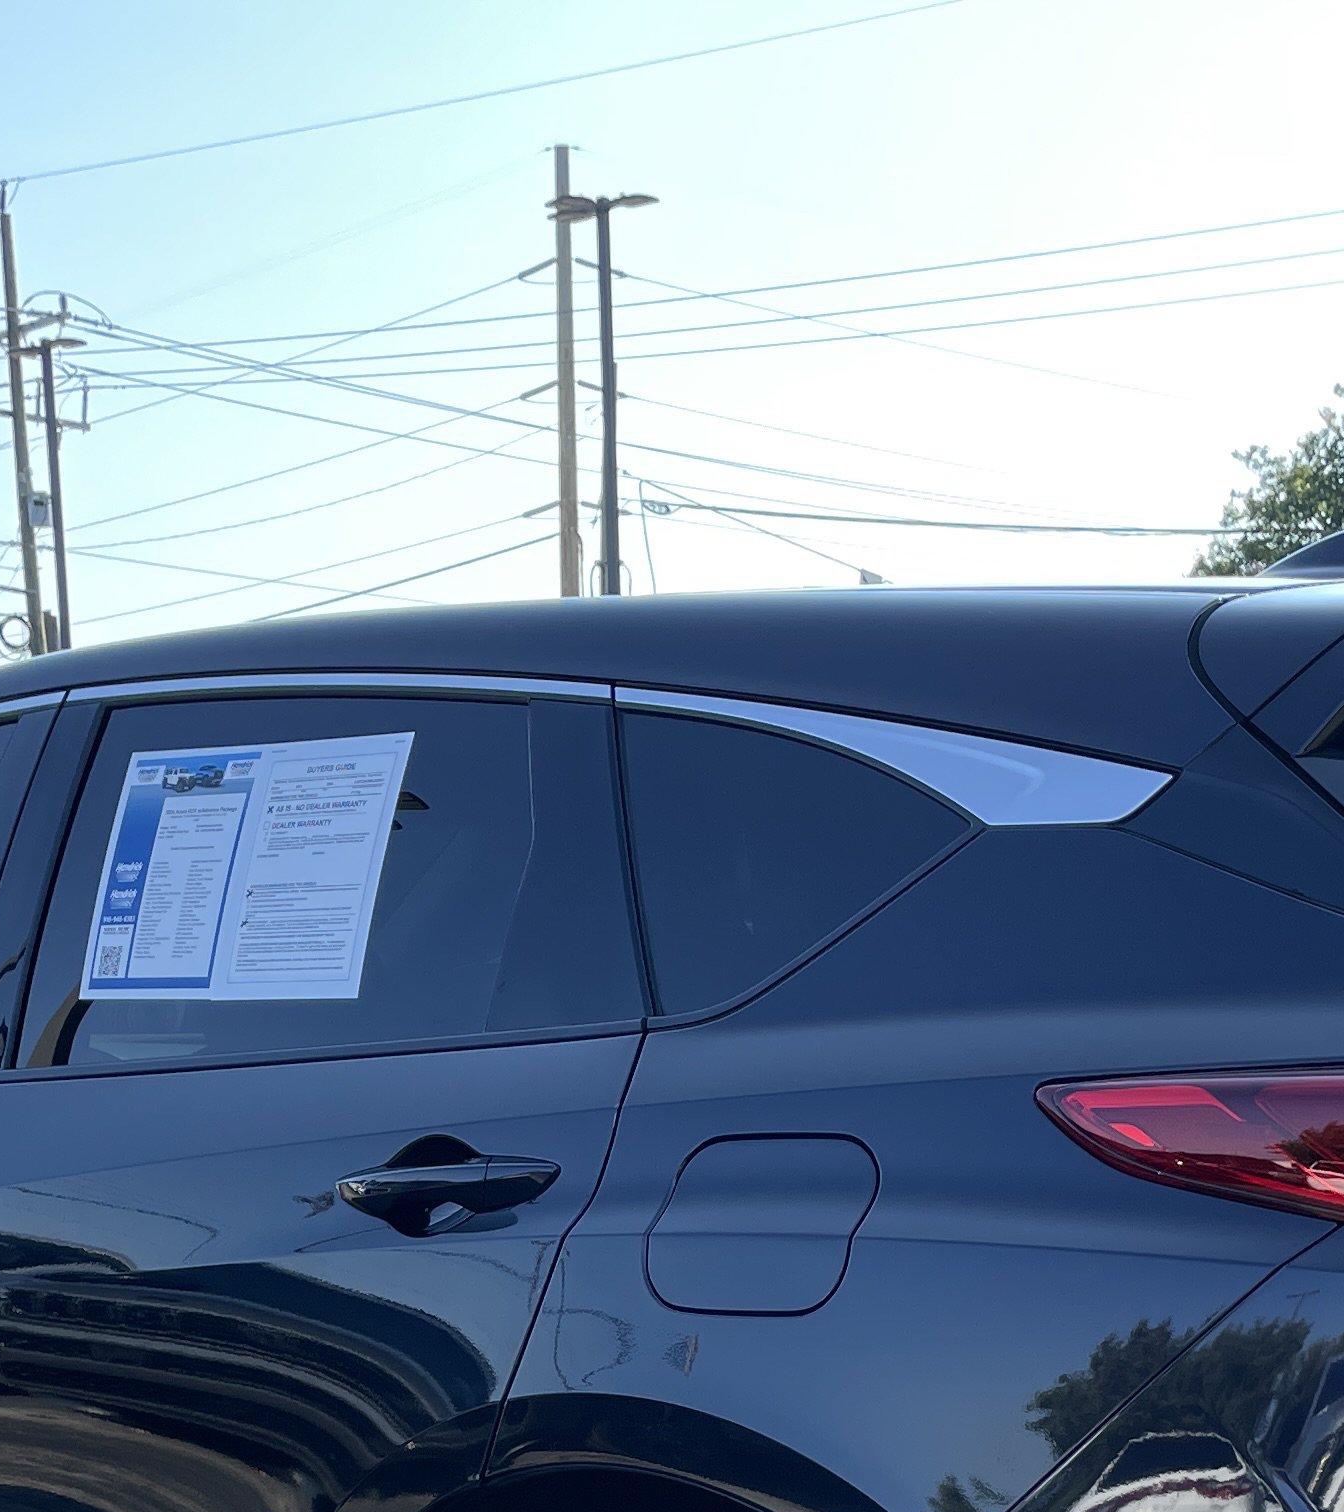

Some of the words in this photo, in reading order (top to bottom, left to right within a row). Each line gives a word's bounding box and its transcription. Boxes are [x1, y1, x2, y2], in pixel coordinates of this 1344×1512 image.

[307, 764, 334, 774] BUYERS
[335, 762, 357, 772] GUIDE
[272, 821, 296, 830] DEALER
[297, 819, 332, 828] WARRANTY
